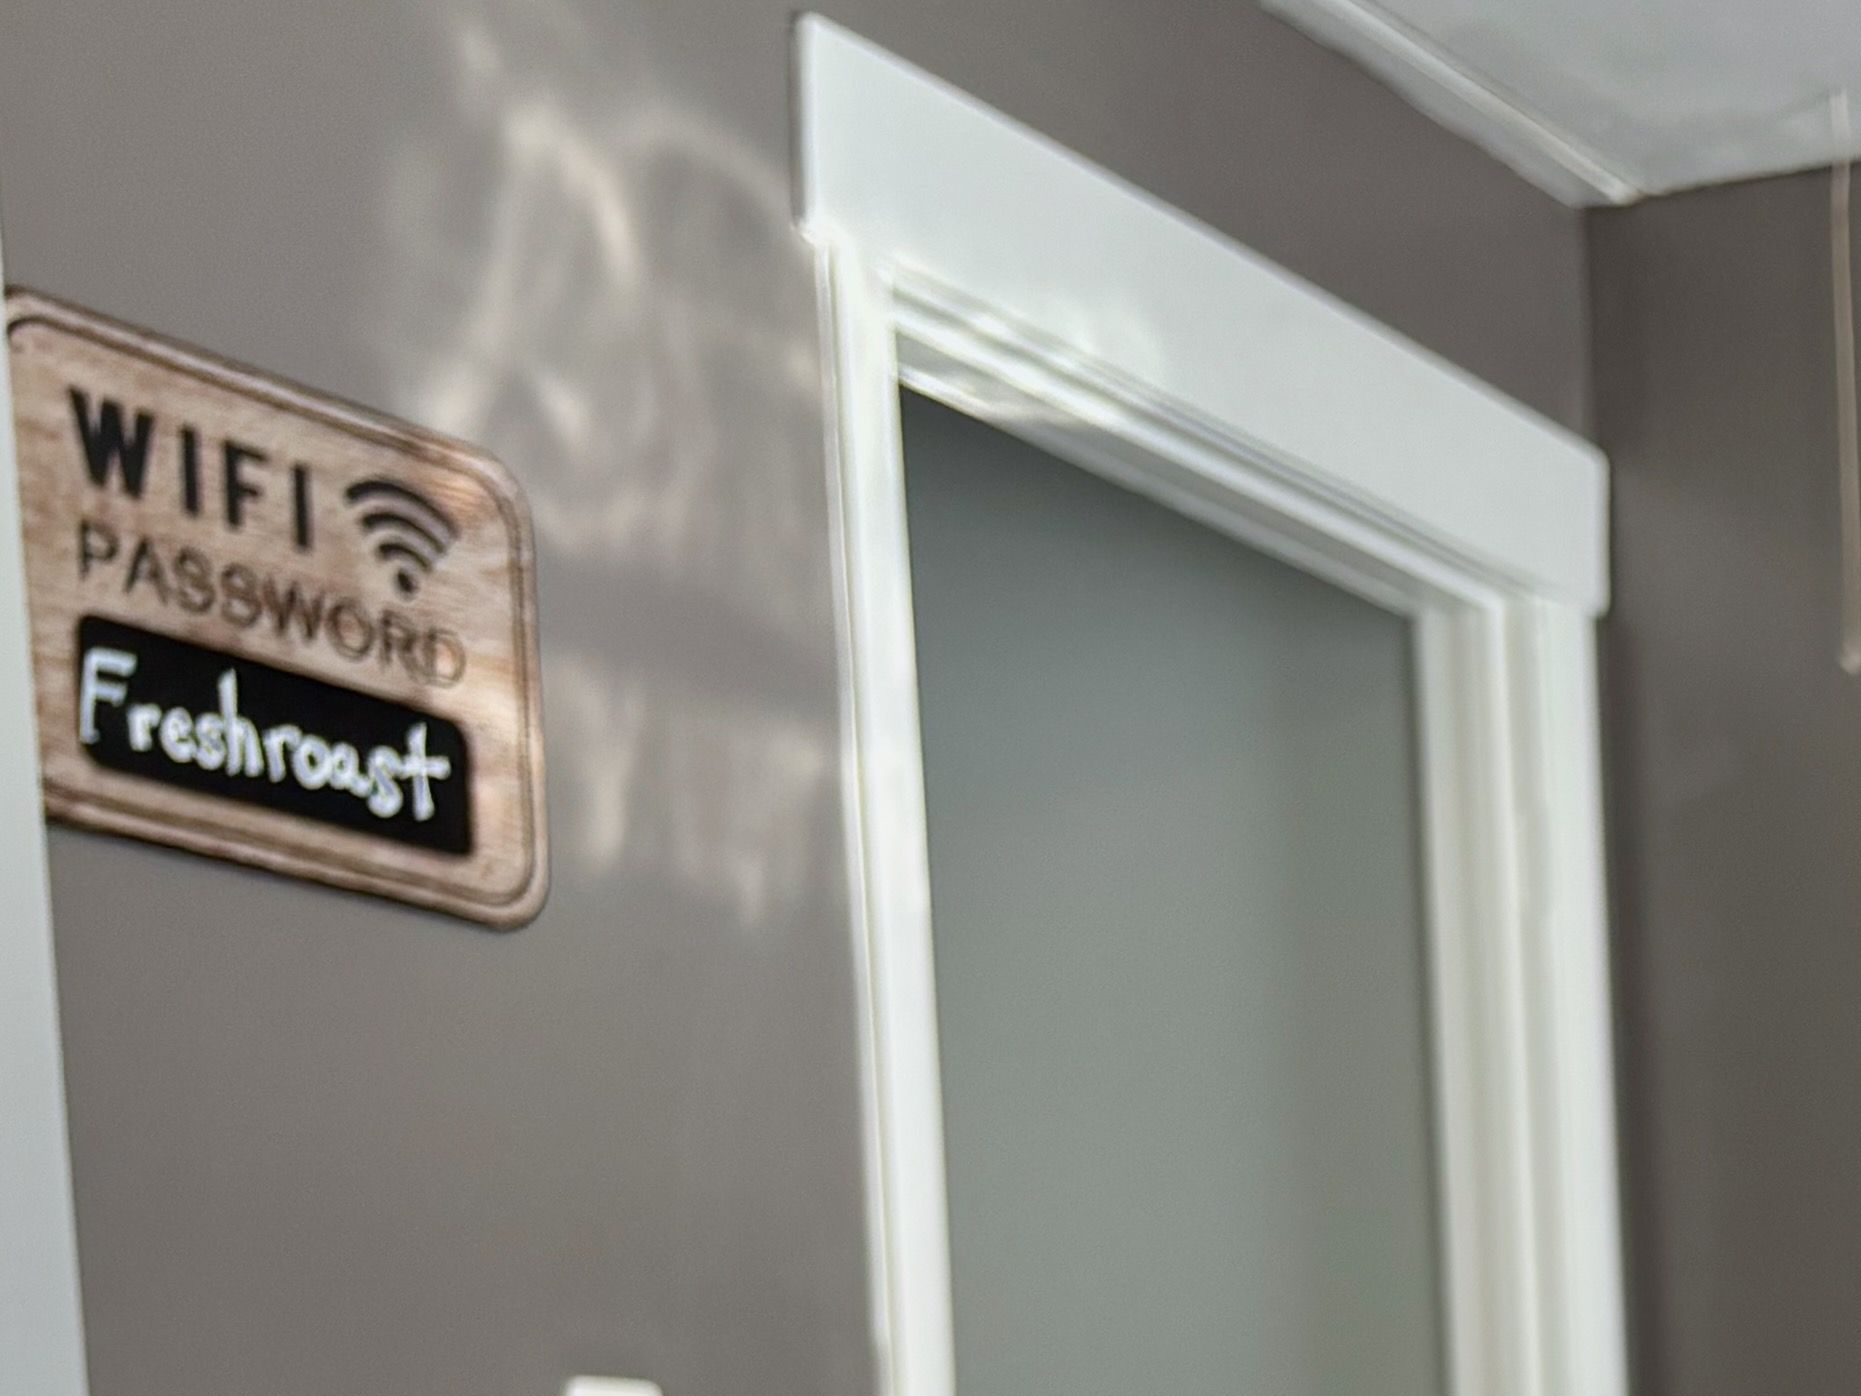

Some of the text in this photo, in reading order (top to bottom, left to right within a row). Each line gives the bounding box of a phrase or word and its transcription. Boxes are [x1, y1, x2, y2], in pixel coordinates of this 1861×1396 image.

[67, 385, 314, 553] WIFI
[79, 518, 468, 689] PASSWORD
[79, 648, 451, 821] Freshroast
